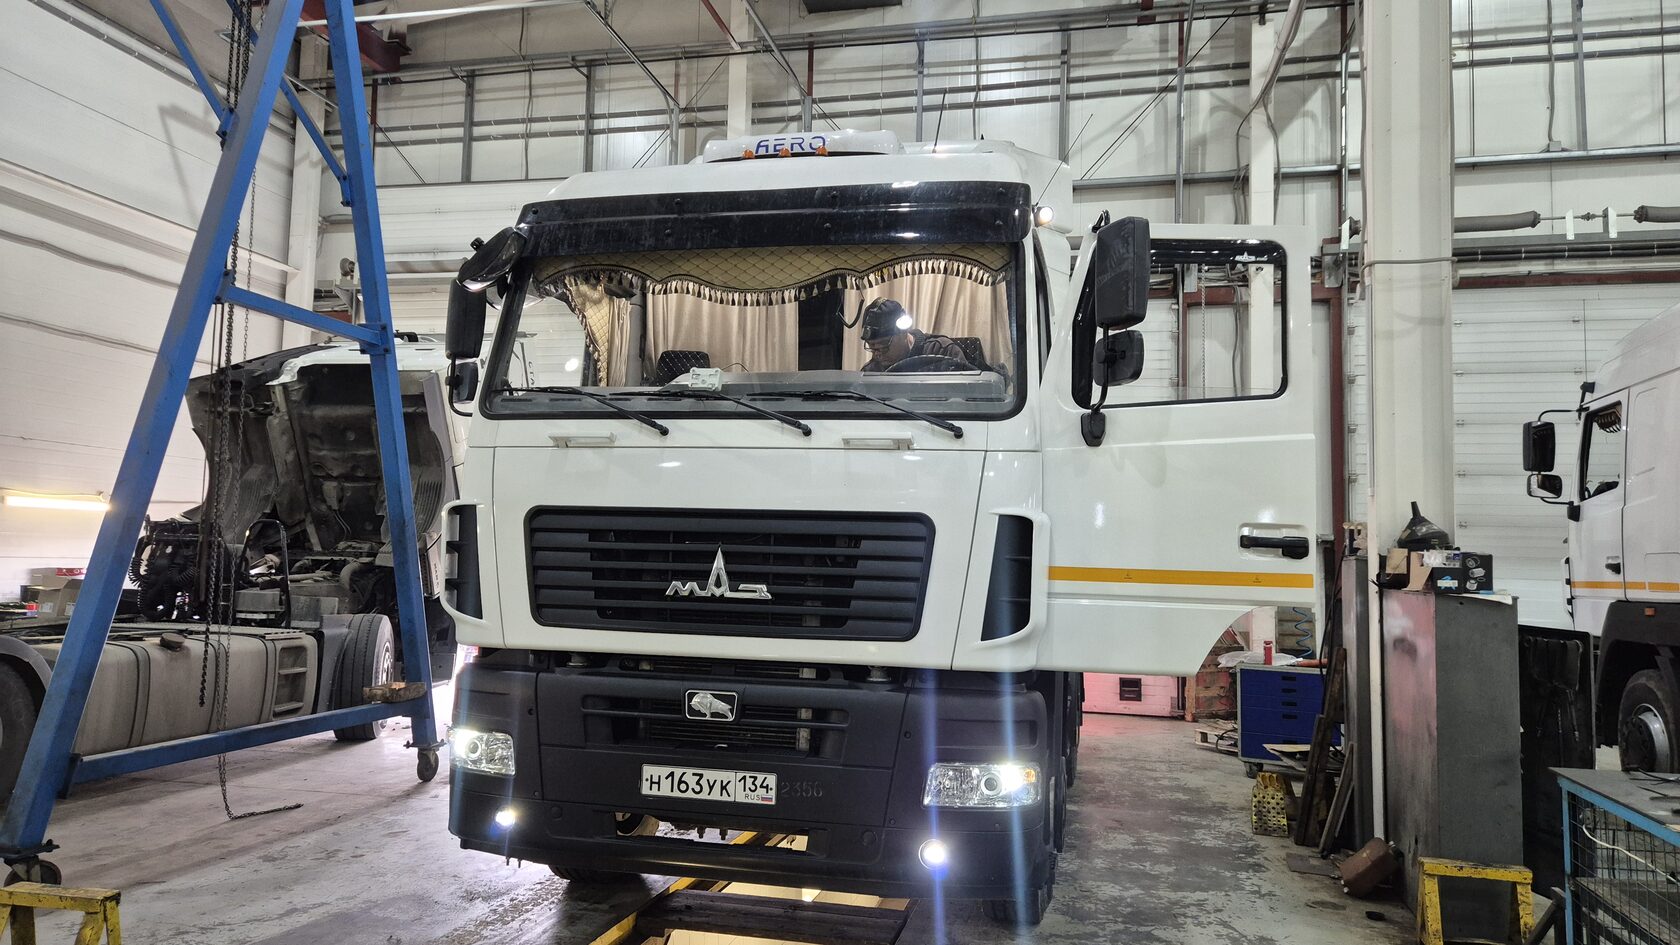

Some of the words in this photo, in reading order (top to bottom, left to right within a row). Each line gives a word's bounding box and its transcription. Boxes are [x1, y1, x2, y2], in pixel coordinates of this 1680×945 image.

[755, 136, 826, 154] AERO
[738, 775, 770, 794] 134
[744, 793, 761, 801] RUS
